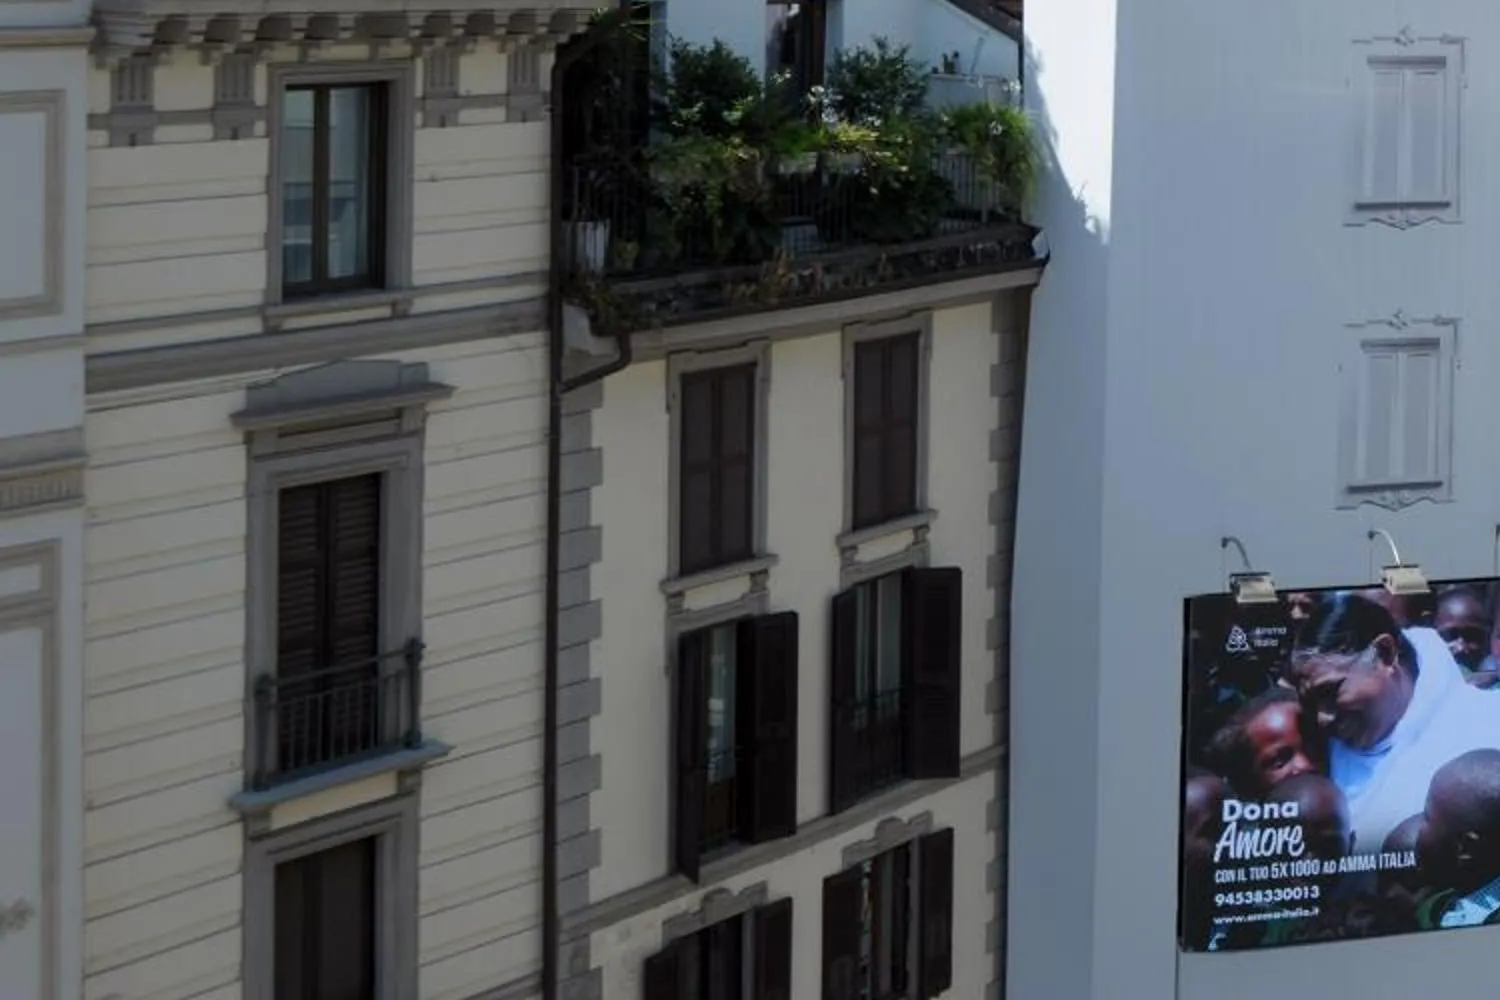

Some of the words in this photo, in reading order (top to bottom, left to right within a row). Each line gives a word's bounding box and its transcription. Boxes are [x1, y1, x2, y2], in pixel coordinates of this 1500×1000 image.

[1223, 799, 1299, 822] Dona
[1213, 821, 1305, 863] Amore
[1215, 869, 1236, 883] CON
[1237, 868, 1247, 881] IL
[1250, 867, 1269, 880] TUO
[1322, 861, 1337, 874] AD
[1338, 855, 1377, 873] AMMA
[1378, 852, 1416, 869] ITALIA
